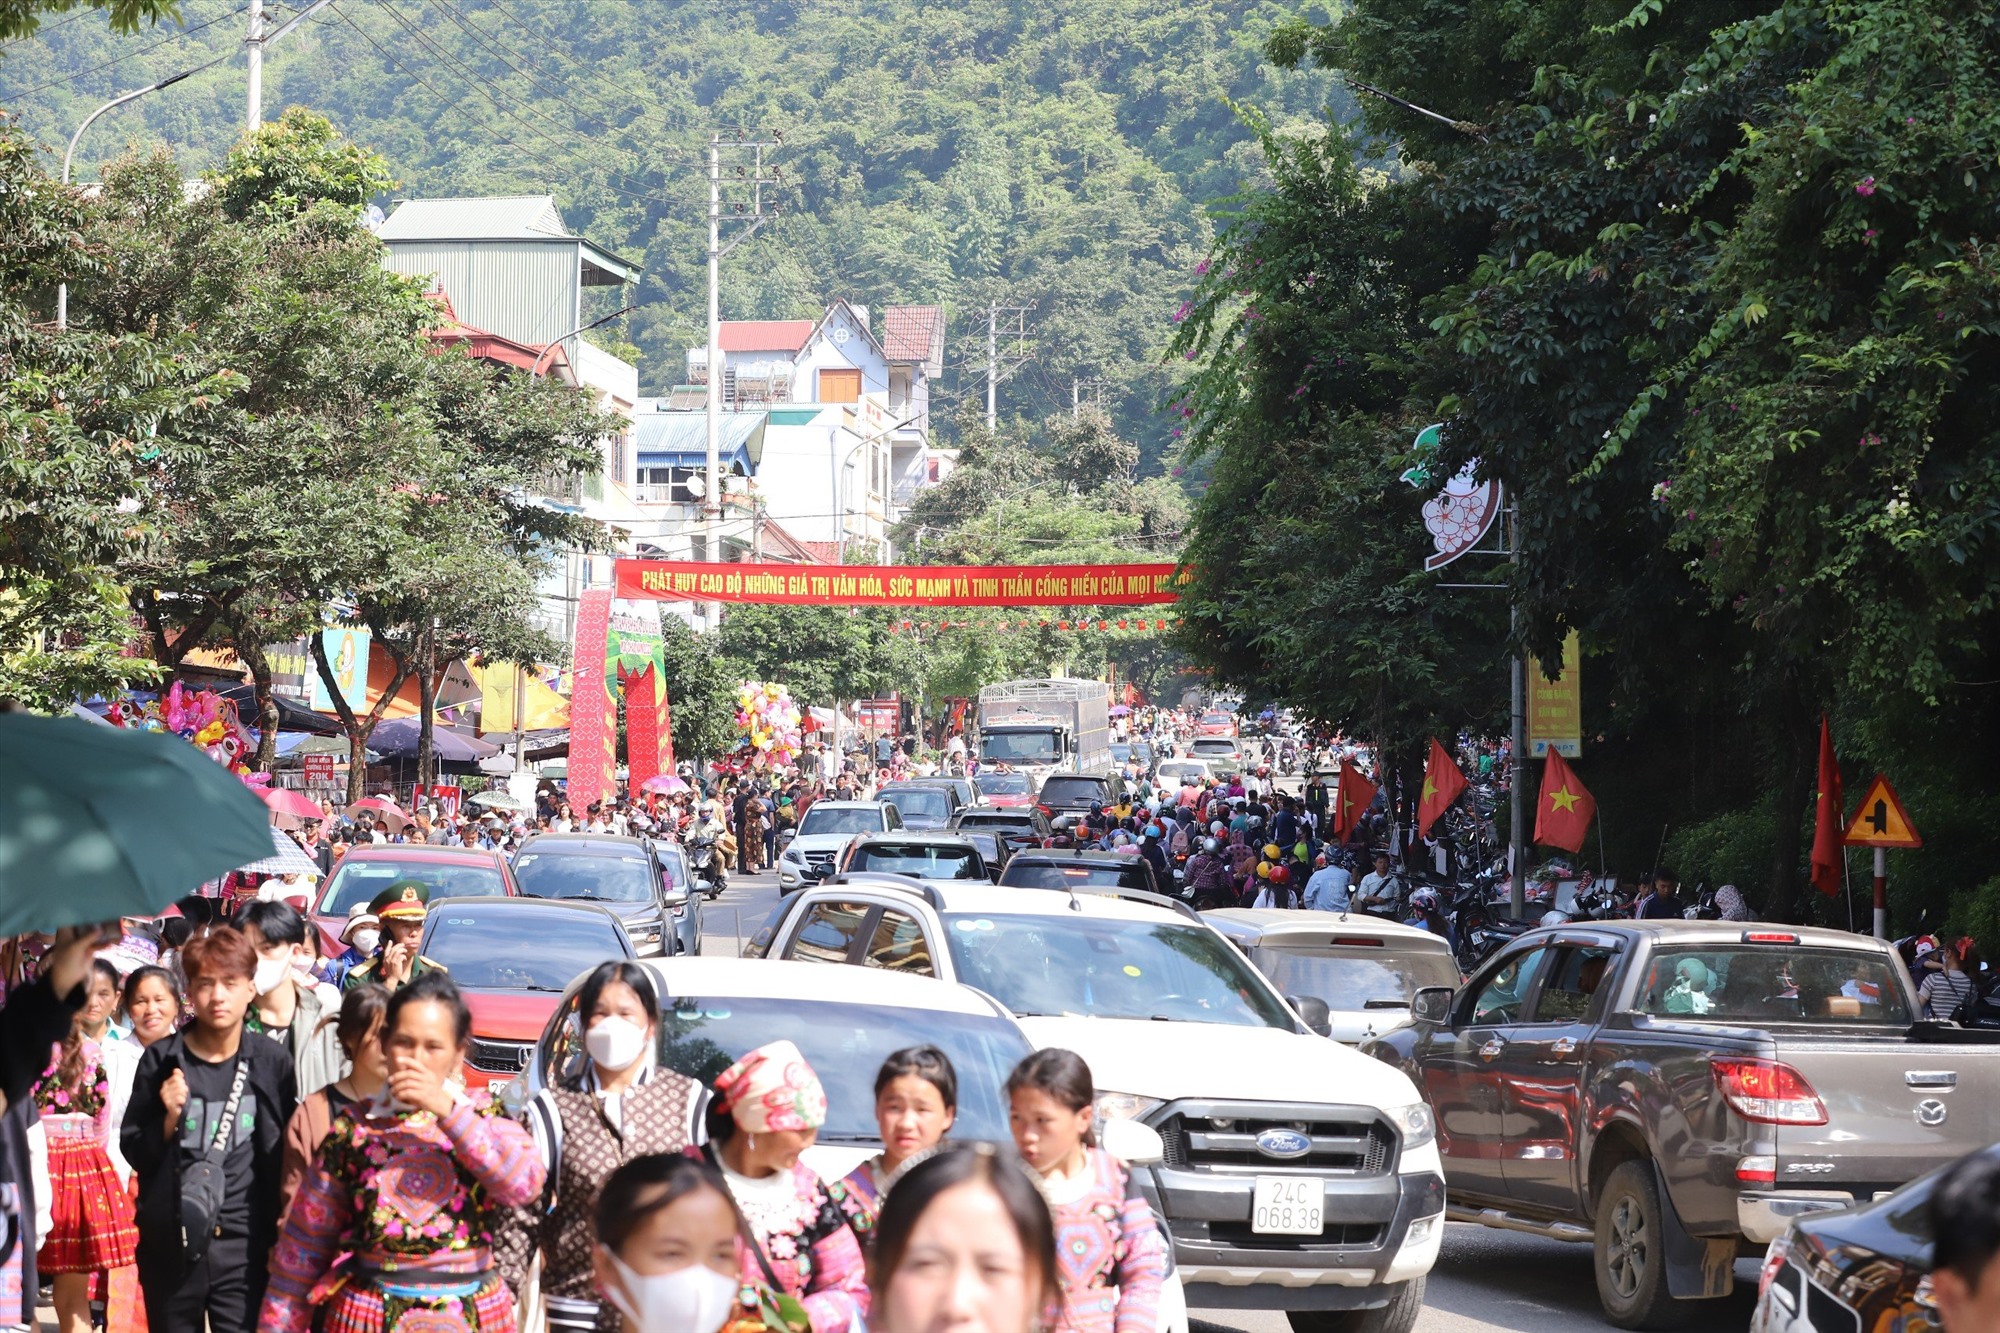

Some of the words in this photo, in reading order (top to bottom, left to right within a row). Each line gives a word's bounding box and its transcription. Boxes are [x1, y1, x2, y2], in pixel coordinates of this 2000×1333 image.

[642, 568, 672, 591] PHÁT
[675, 572, 697, 593] HUY
[700, 573, 723, 594] CAO
[726, 571, 742, 599] ĐỘ
[745, 572, 785, 595] NHỮNG
[788, 572, 808, 596] GIÁ
[811, 576, 829, 600] TRỊ
[833, 573, 856, 596] VĂN
[859, 574, 886, 599] HÓA,
[889, 574, 913, 598] SỨC
[916, 578, 951, 602] MẠNH
[954, 574, 969, 598] VÀ
[972, 578, 998, 598] TINH
[1002, 571, 1032, 598] THẦN
[1035, 571, 1068, 597] CỐNG
[1071, 570, 1098, 596] HIẾN
[1101, 569, 1124, 596] CỦA
[1127, 575, 1150, 599] MỌI
[309, 772, 329, 780] 20K
[1268, 1135, 1301, 1151] Ford
[1272, 1182, 1307, 1205] 24C
[1257, 1206, 1320, 1230] 068.38
